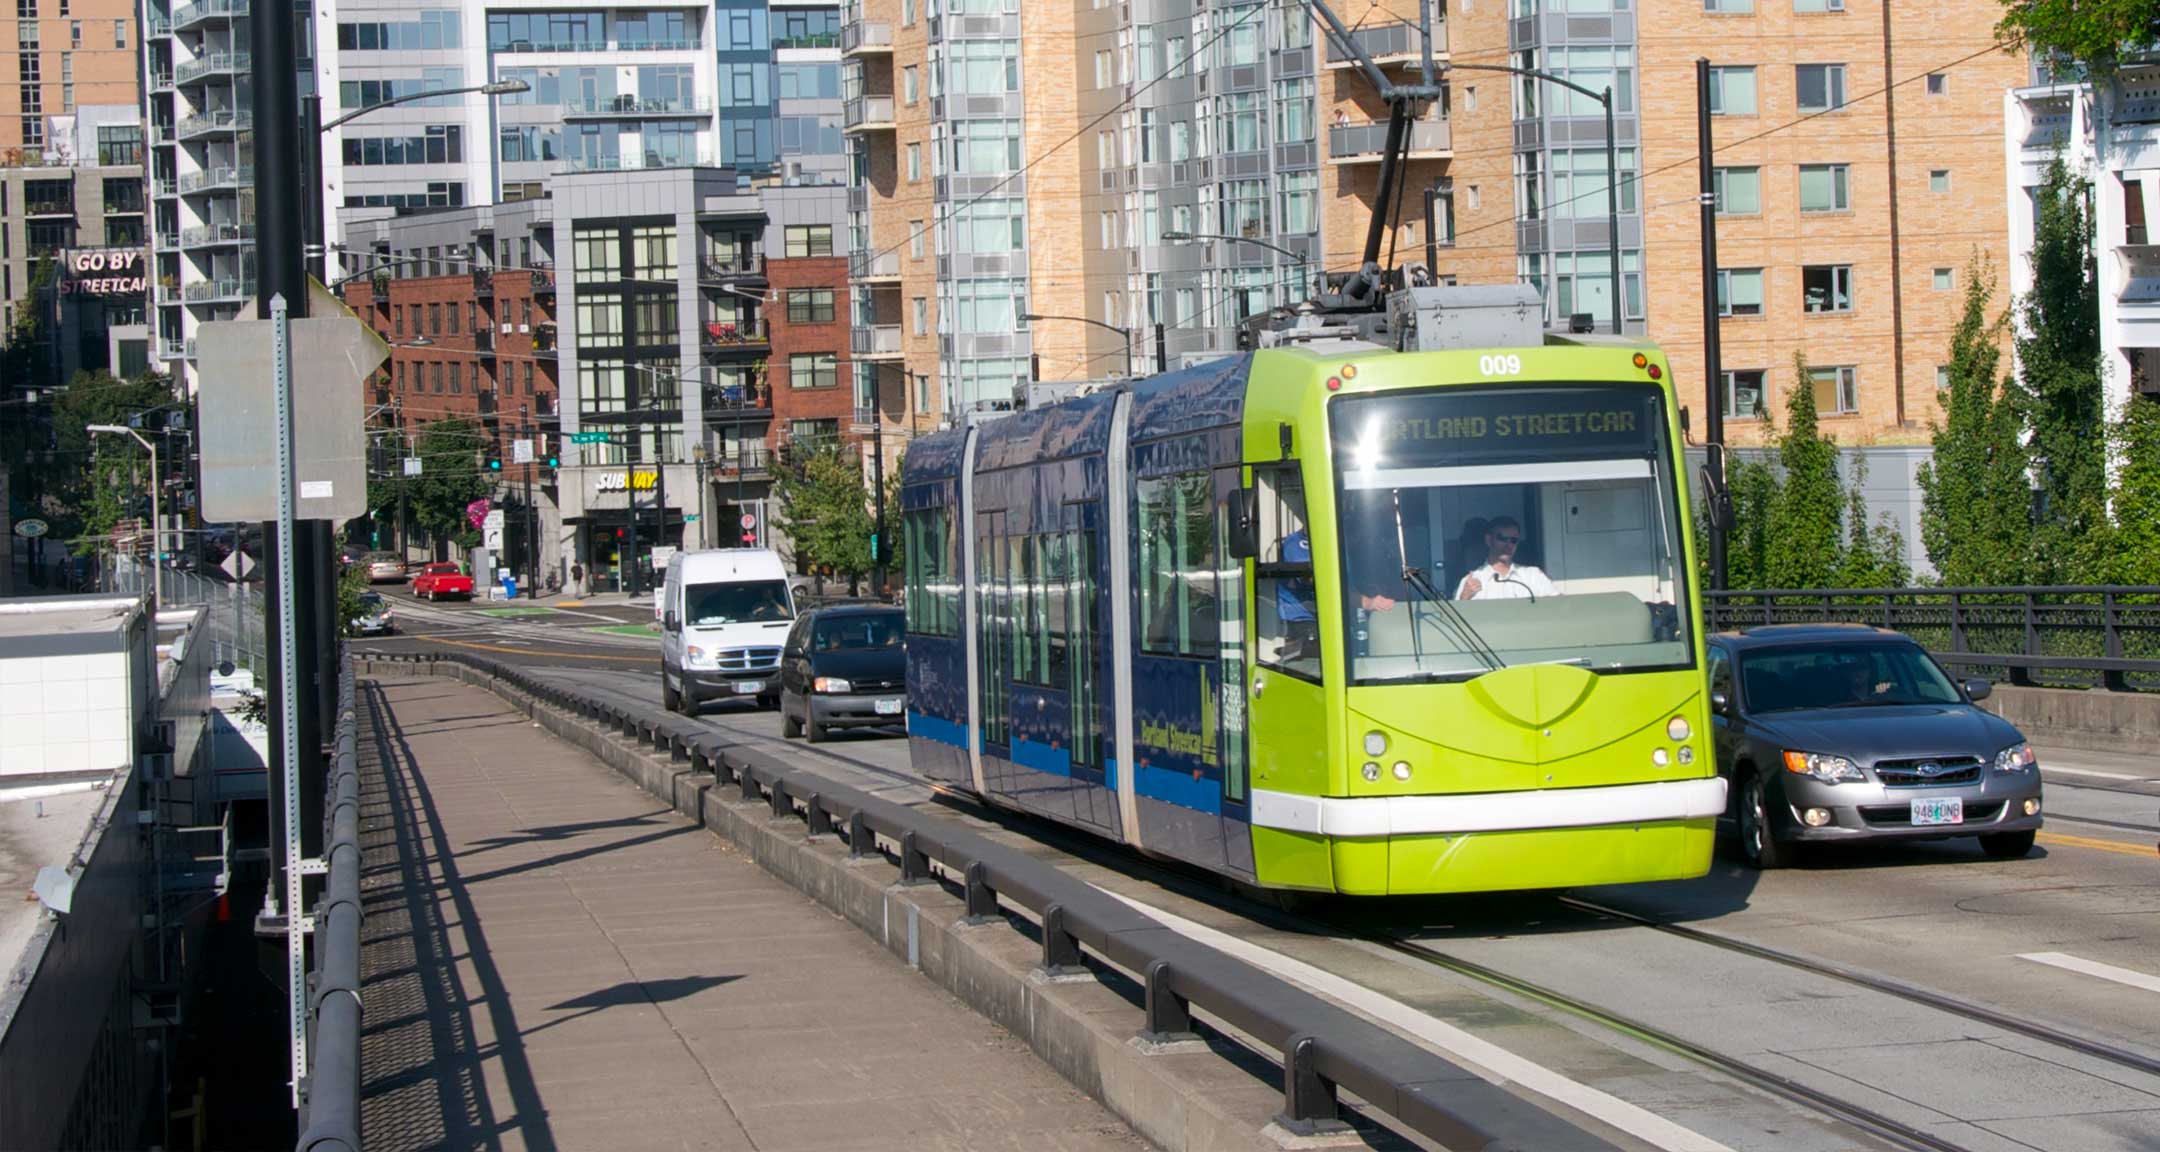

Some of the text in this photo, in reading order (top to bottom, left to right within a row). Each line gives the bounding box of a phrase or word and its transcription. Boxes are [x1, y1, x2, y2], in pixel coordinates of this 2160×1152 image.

[76, 252, 136, 271] GO BY
[1480, 354, 1521, 376] 009
[1495, 411, 1636, 437] STREETCAR
[1914, 804, 1933, 818] 948
